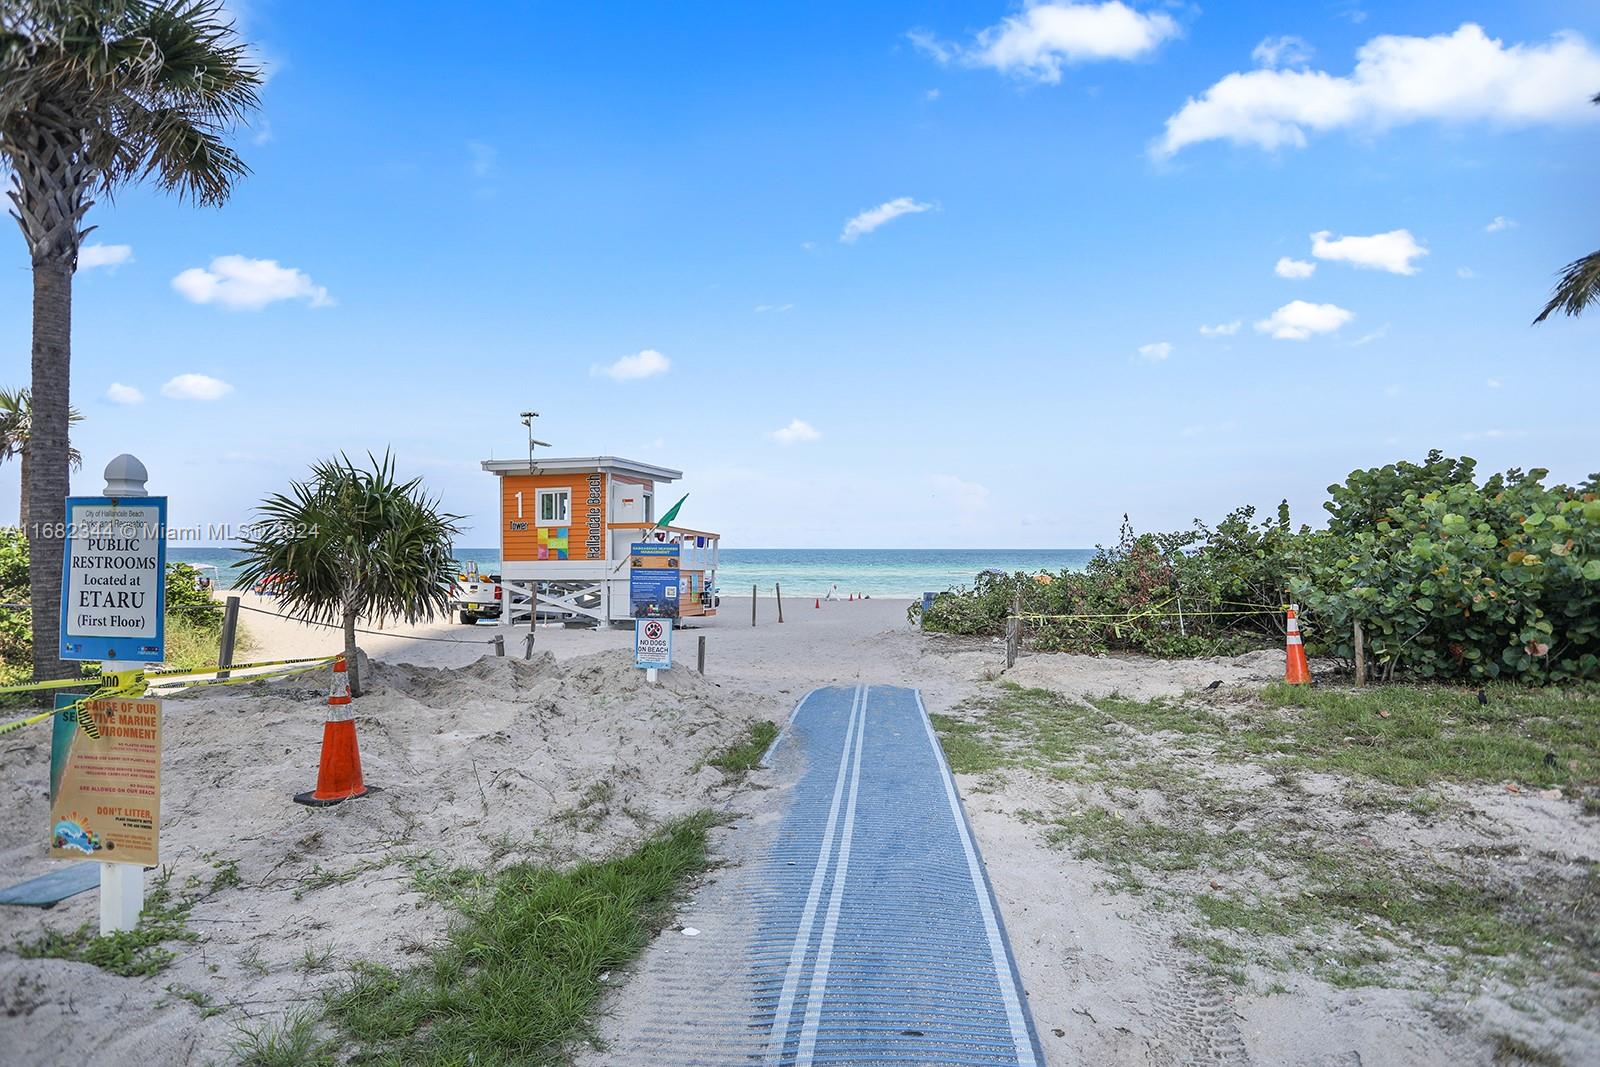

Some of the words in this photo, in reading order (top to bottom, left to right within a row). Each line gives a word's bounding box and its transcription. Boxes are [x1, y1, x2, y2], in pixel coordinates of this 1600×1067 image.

[586, 473, 602, 506] Beach
[514, 491, 523, 518] 1
[86, 510, 94, 518] City
[510, 520, 528, 530] Tower
[586, 507, 601, 560] Hallandale
[88, 538, 140, 552] PUBLIC
[73, 556, 156, 570] RESTROOMS
[84, 574, 127, 586] Located
[130, 576, 141, 586] at
[79, 590, 145, 608] ETARU
[77, 614, 106, 628] (First
[110, 615, 145, 630] Floor)
[121, 703, 134, 713] OF
[136, 703, 156, 714] OUR
[119, 715, 156, 727] MARINE
[98, 726, 156, 740] VIRONMENT
[97, 806, 122, 815] DON'T
